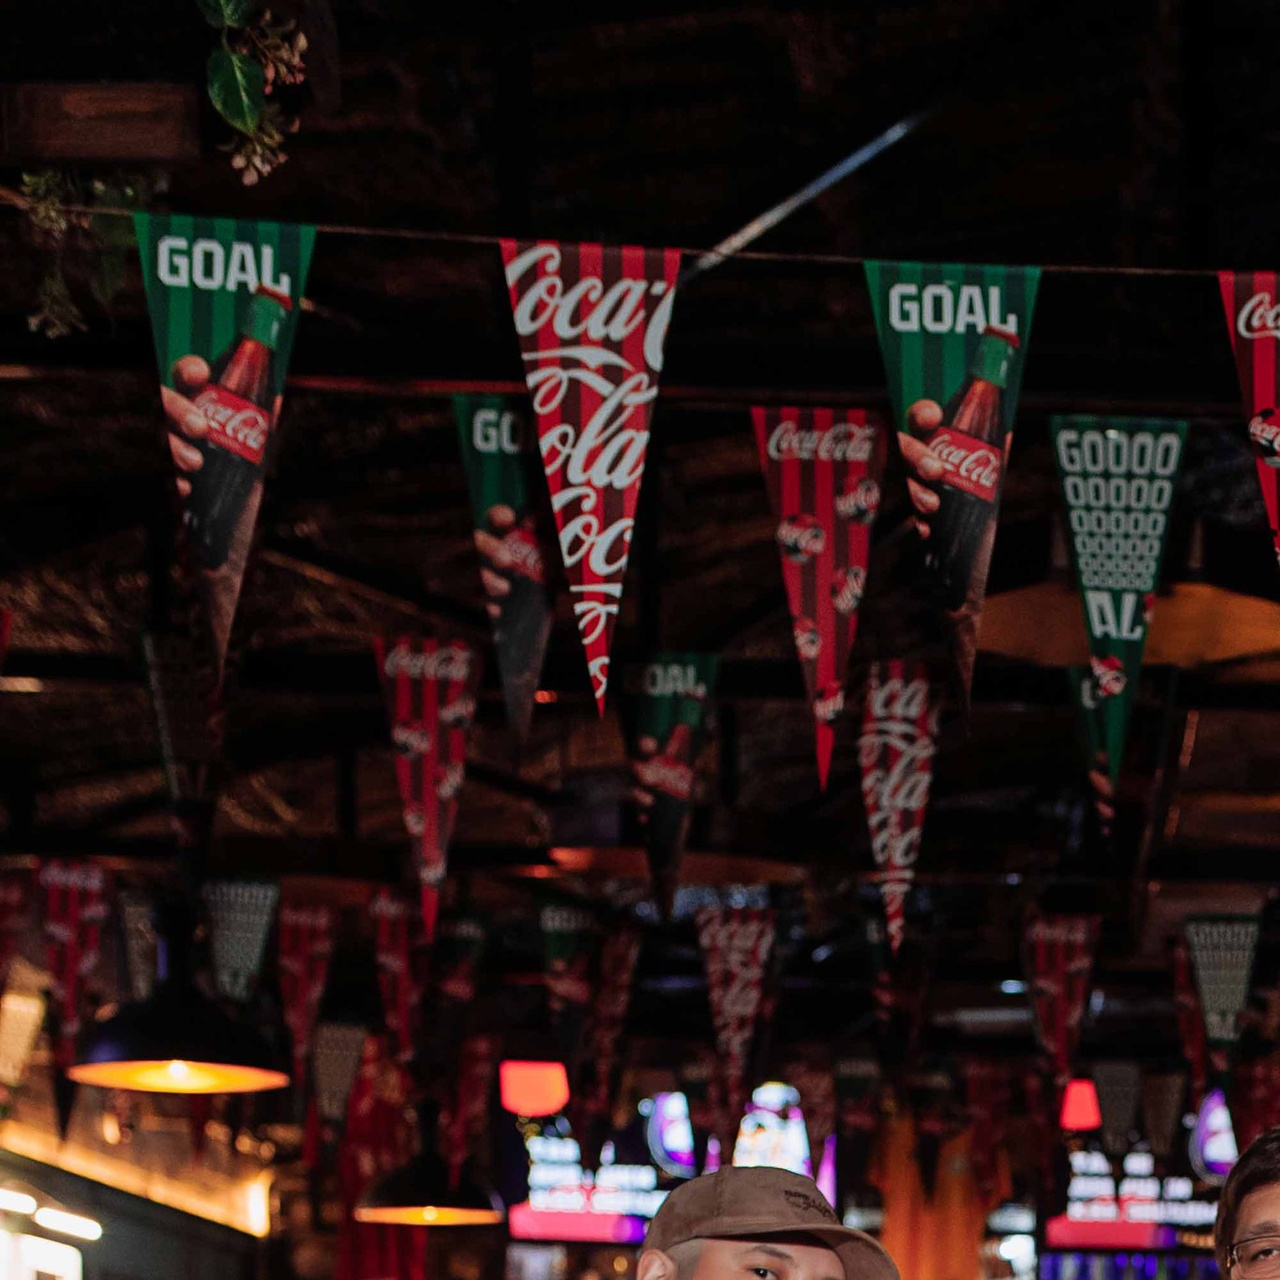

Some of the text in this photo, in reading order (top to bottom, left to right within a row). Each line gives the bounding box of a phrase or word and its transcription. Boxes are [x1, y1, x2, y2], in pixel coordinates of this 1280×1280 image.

[157, 235, 291, 296] GOAL
[888, 282, 1018, 336] GOAL
[1056, 428, 1182, 477] GOOOO
[1084, 590, 1143, 641] AL
